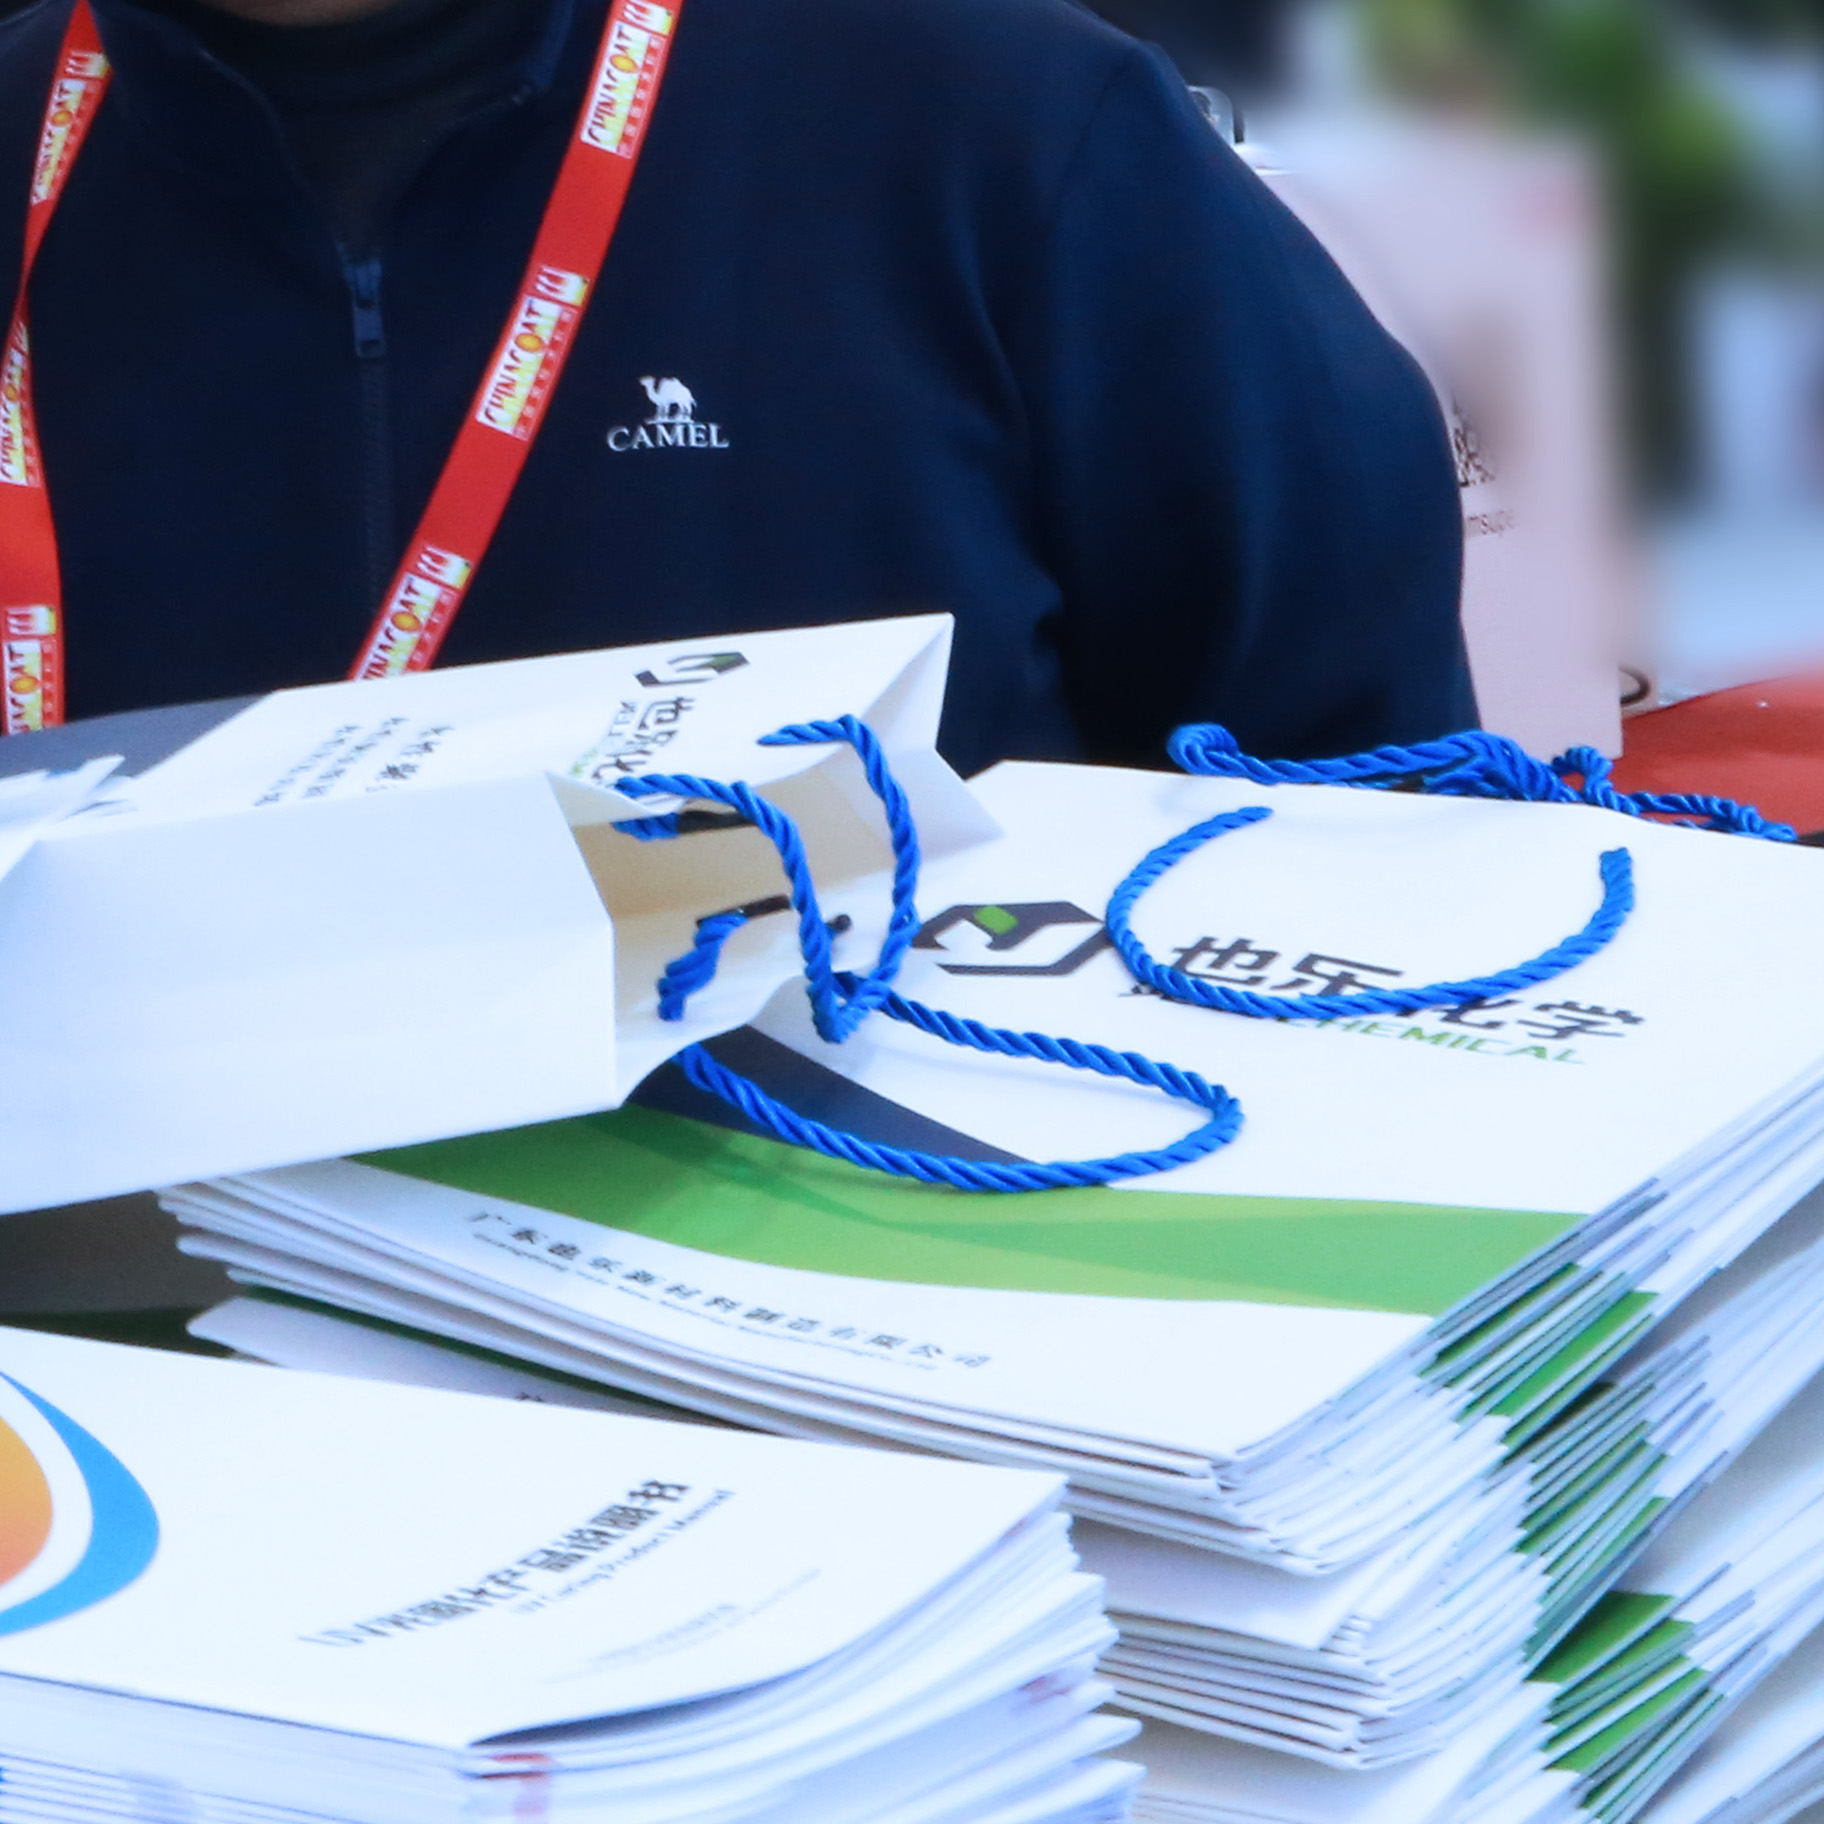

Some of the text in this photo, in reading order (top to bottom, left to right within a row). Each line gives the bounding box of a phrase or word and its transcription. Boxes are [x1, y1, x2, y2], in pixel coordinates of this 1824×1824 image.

[583, 23, 648, 150] CHINACOAT
[479, 295, 559, 432] CHINACOAT
[607, 420, 730, 452] CAMEL
